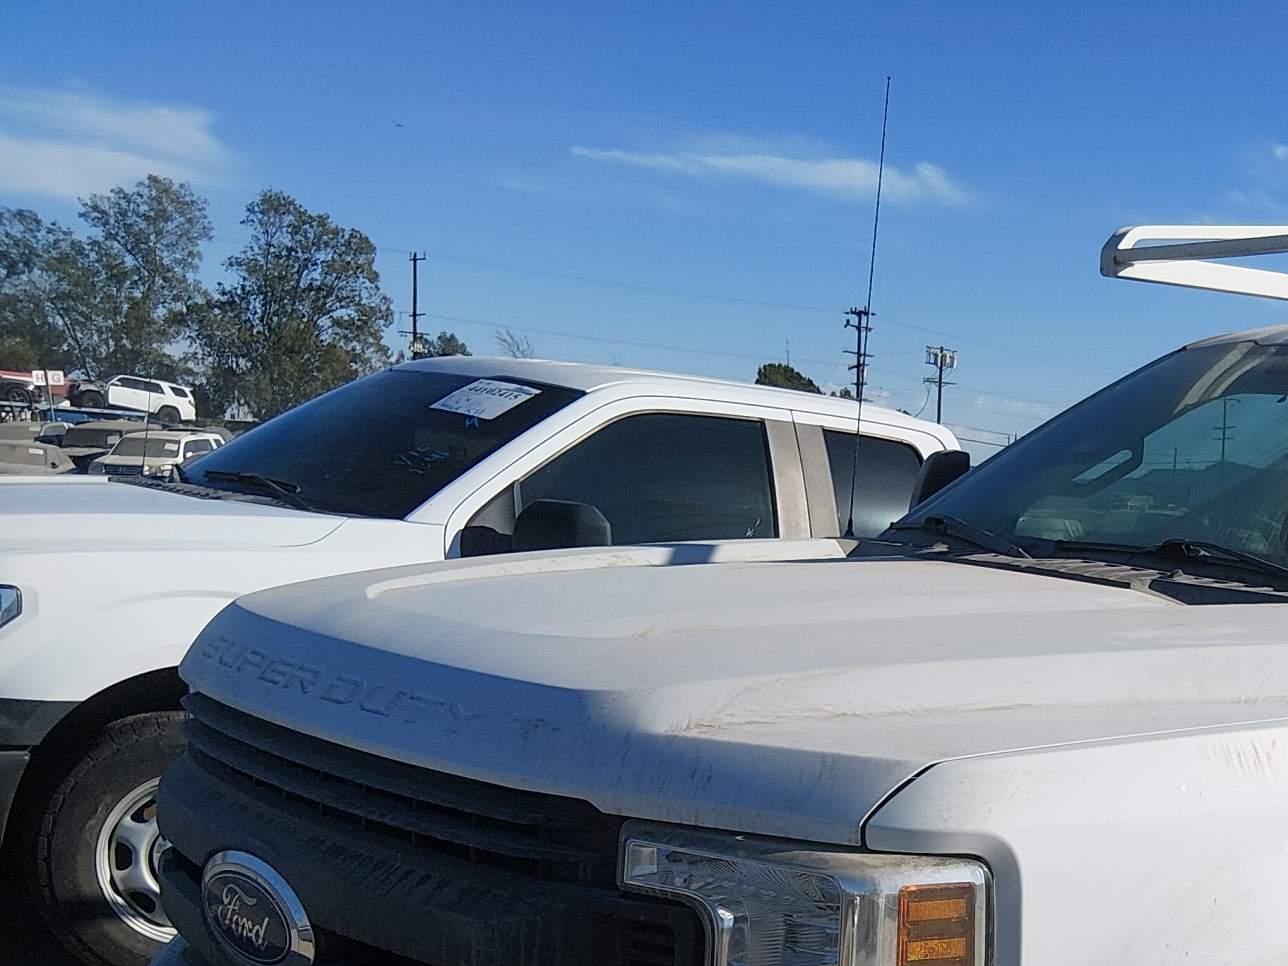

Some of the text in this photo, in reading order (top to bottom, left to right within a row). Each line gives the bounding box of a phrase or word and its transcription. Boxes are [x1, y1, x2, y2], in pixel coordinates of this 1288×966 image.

[201, 635, 491, 734] SUPER DUTY
[217, 883, 270, 952] Ford
